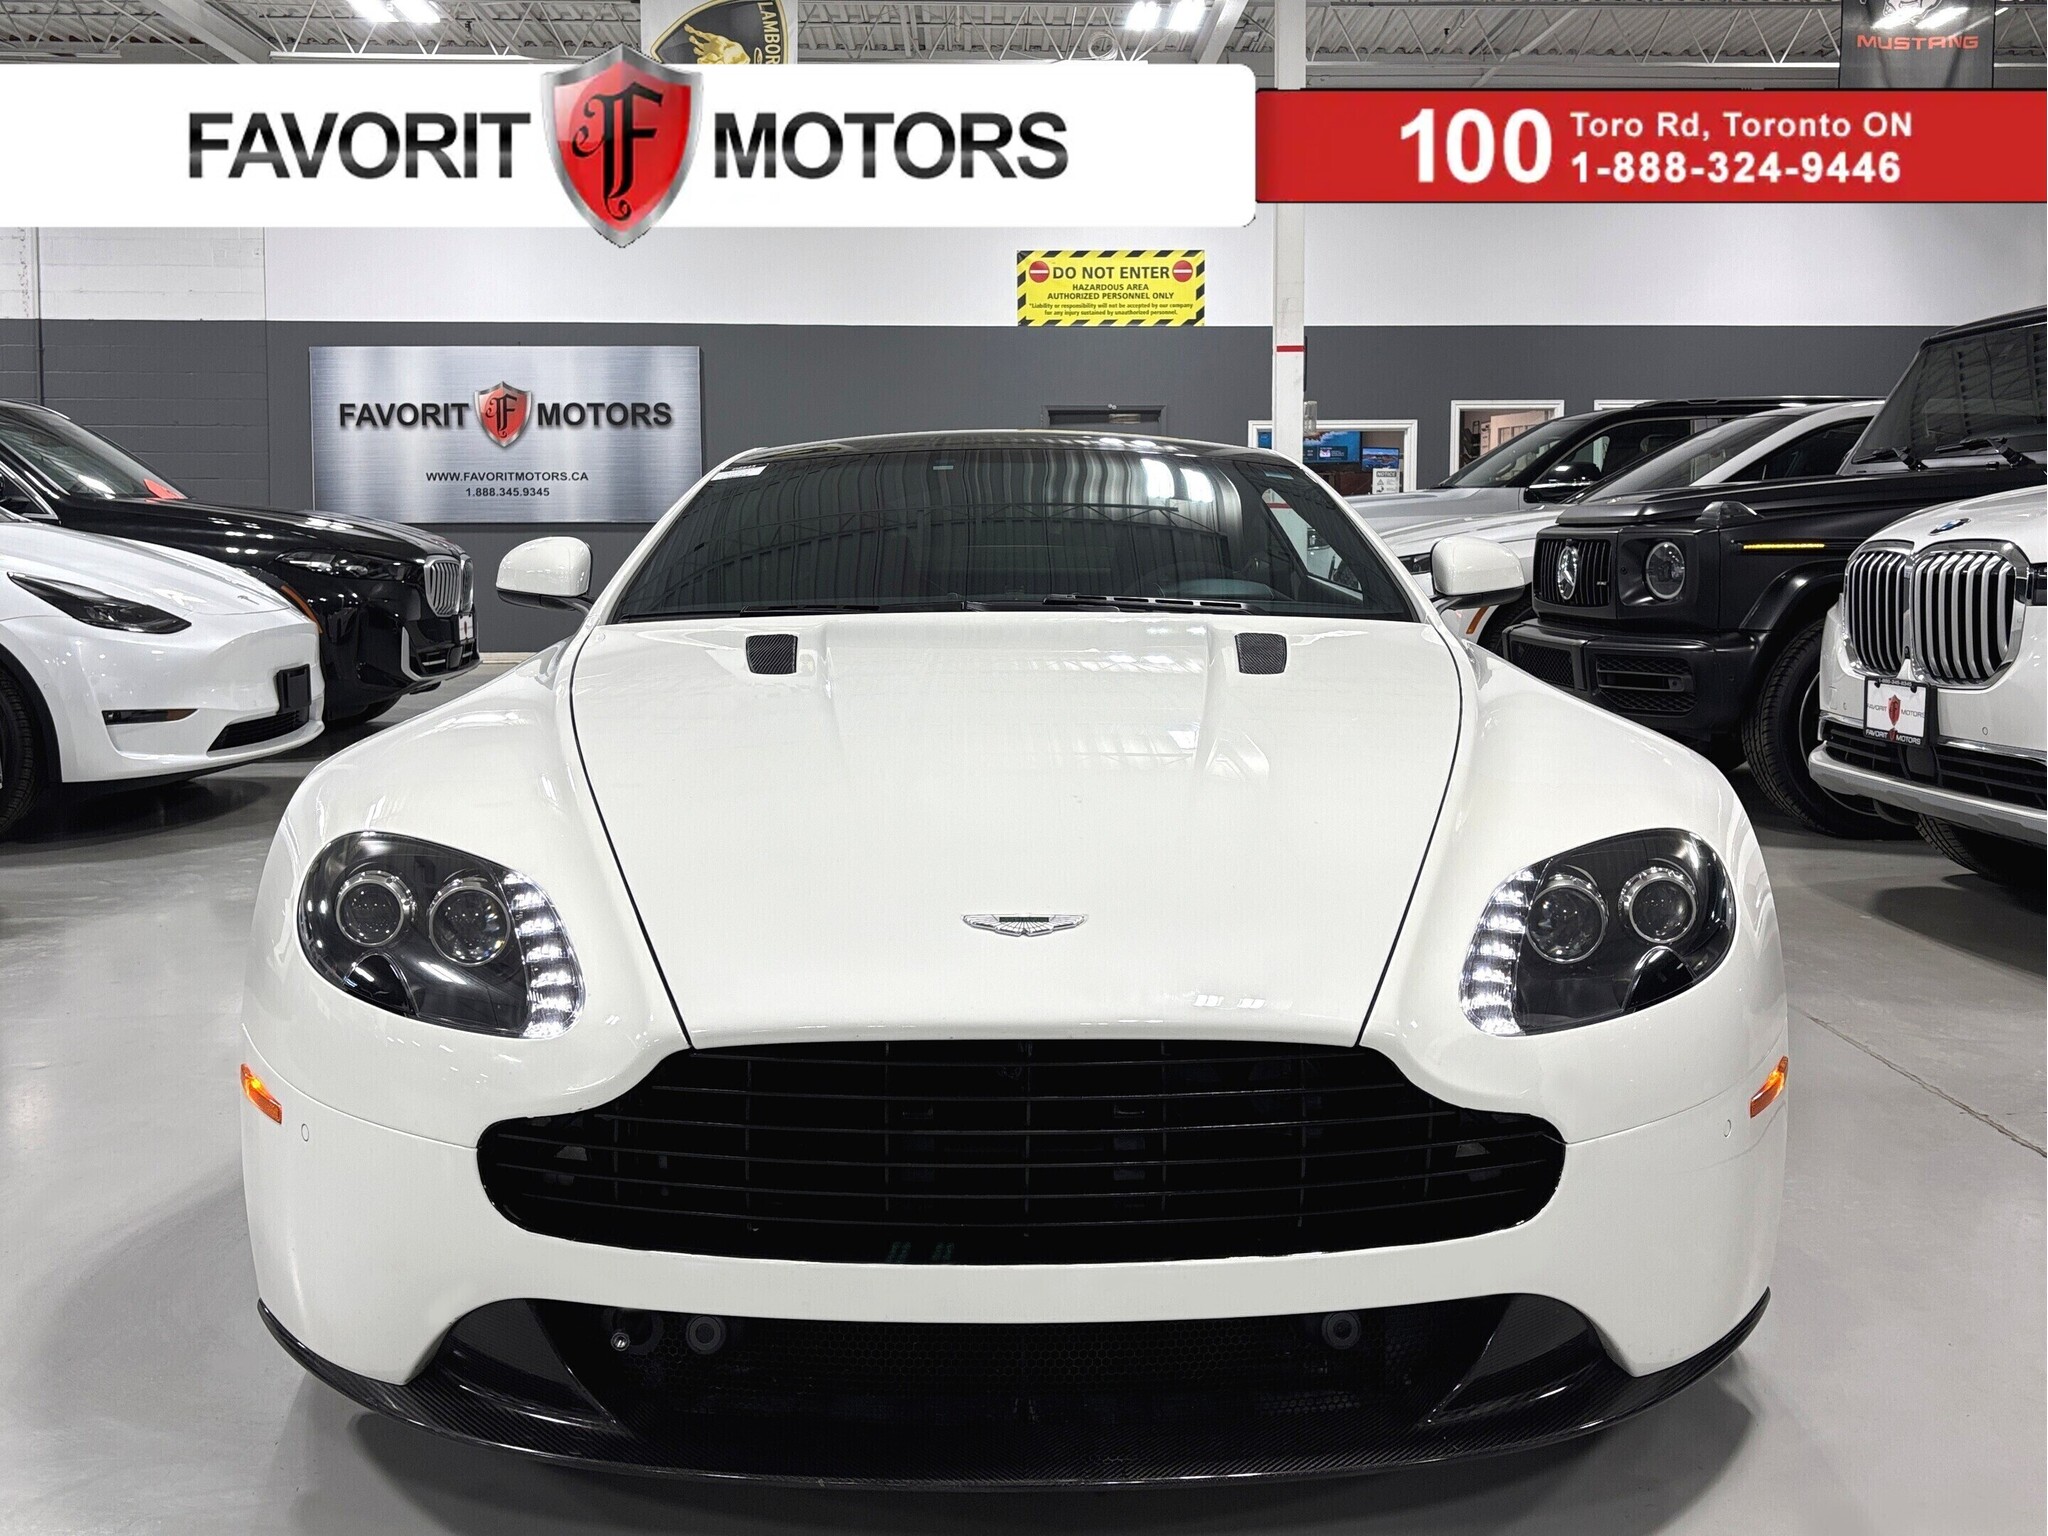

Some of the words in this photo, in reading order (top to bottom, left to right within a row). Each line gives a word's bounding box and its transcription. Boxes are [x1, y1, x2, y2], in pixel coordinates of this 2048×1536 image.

[1857, 35, 1979, 50] MUSTANG
[1053, 266, 1077, 279] DO
[1082, 266, 1115, 279] NOT
[1120, 266, 1170, 279] ENTER
[1047, 292, 1100, 300] AUTHORIZED
[1102, 292, 1150, 300] PERSONNEL
[1152, 292, 1174, 300] ONLY
[340, 402, 469, 427] FAVORIT
[537, 402, 672, 427] MOTORS
[426, 472, 589, 481] WWW.FAVORITMOTORS.CA
[466, 488, 550, 496] 1.888.345.9345
[1866, 729, 1888, 739] FAVORIT
[1896, 735, 1921, 745] MOTORS
